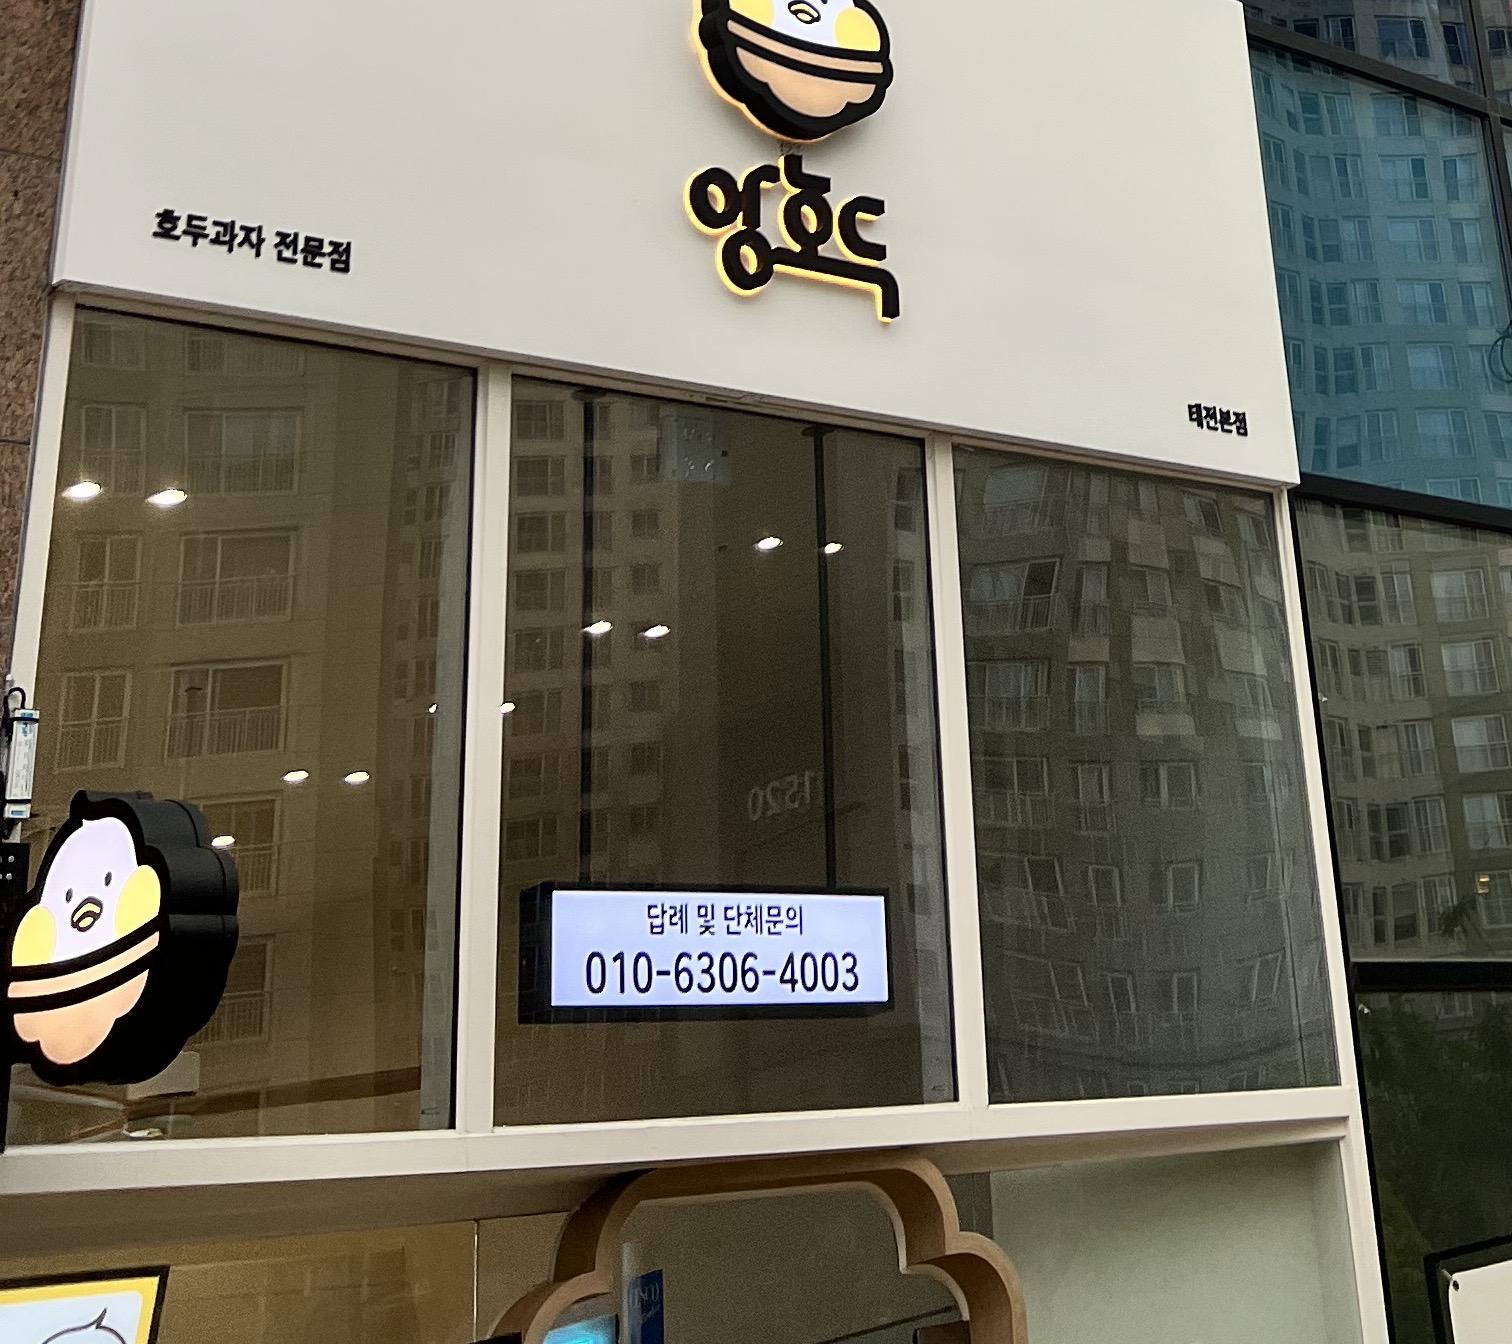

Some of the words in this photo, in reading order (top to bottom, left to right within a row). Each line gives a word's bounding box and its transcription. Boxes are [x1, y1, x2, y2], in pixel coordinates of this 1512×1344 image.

[152, 207, 266, 259] 호두과자
[273, 229, 353, 274] 전문점
[1187, 401, 1249, 438] 태전본점
[646, 903, 690, 937] 답례
[696, 903, 717, 937] 및
[722, 903, 806, 937] 단체문의
[584, 950, 861, 996] 010-6306-4003
